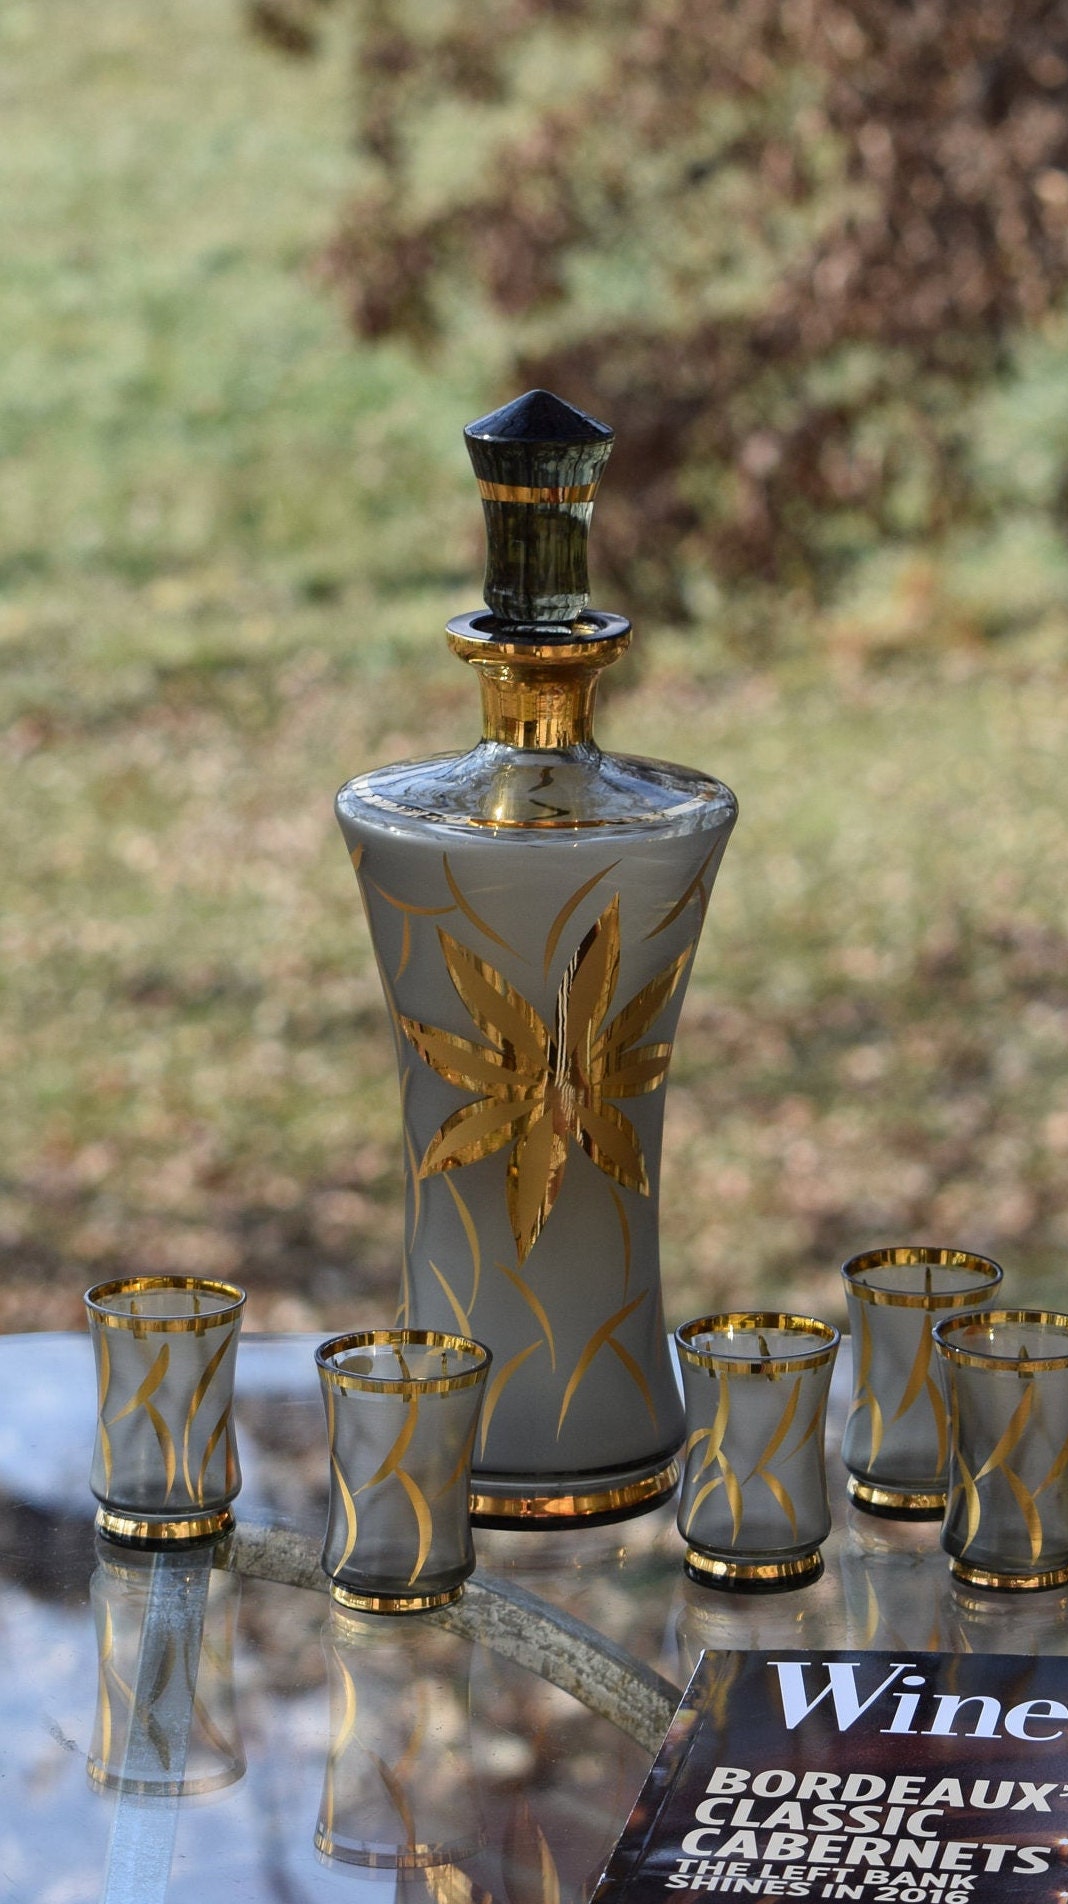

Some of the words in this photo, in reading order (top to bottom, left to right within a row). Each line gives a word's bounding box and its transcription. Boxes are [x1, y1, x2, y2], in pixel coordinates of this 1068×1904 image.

[766, 1661, 1068, 1741] Wine
[695, 1797, 945, 1837] CLASSIC
[681, 1827, 1052, 1874] CABERNETS
[665, 1874, 811, 1897] SHINES
[821, 1884, 864, 1900] IN
[874, 1887, 970, 1904] 2016
[675, 1858, 751, 1877] THE
[760, 1864, 855, 1883] LEFT
[863, 1869, 979, 1890] BANK
